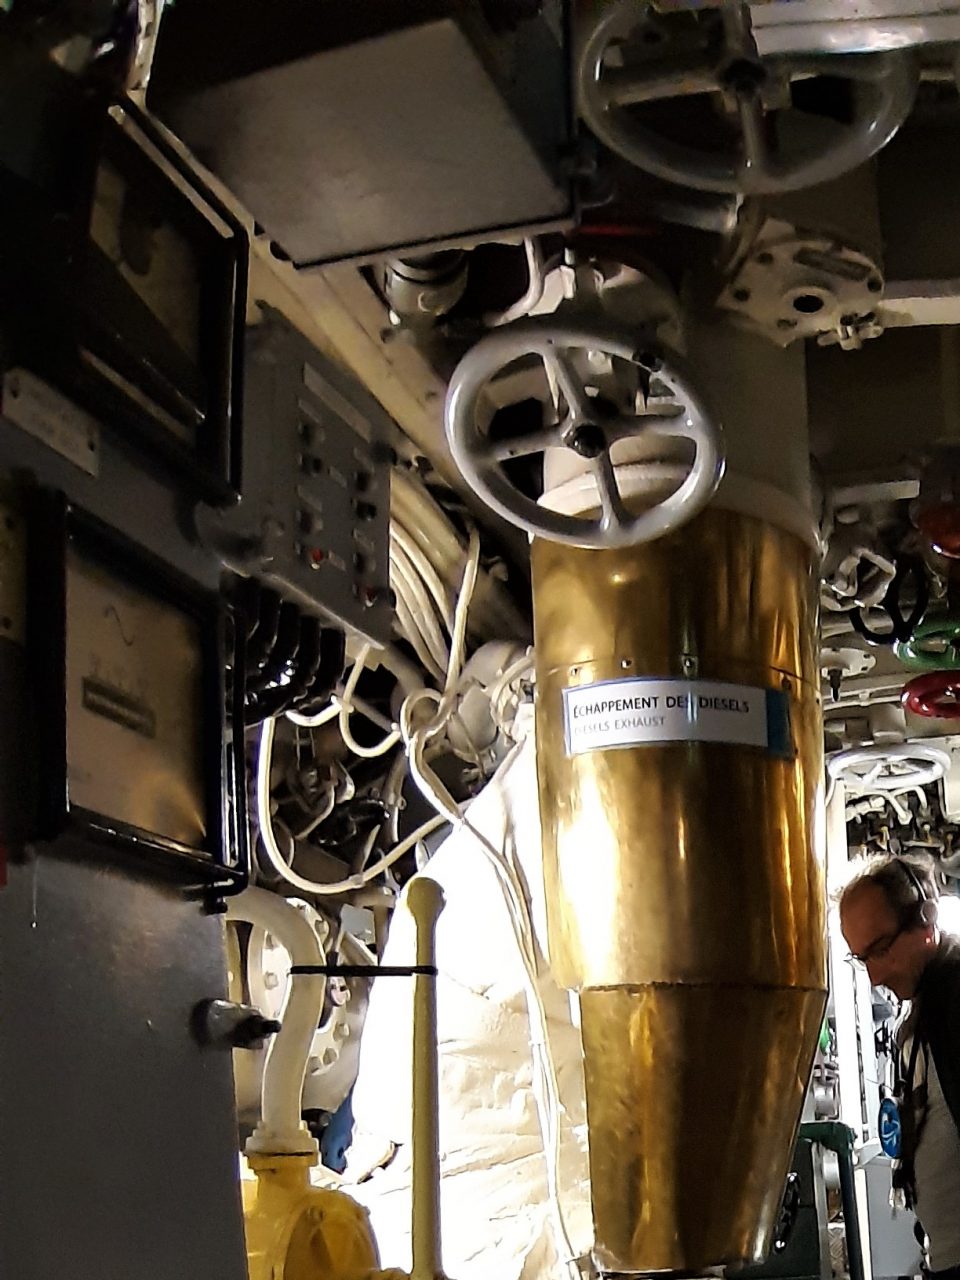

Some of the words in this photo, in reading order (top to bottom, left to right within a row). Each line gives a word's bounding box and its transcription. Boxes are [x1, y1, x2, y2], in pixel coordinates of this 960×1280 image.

[573, 696, 660, 719] ÉCHAPPEMENT
[699, 696, 750, 714] DIESELS
[615, 716, 667, 731] EXHAUST
